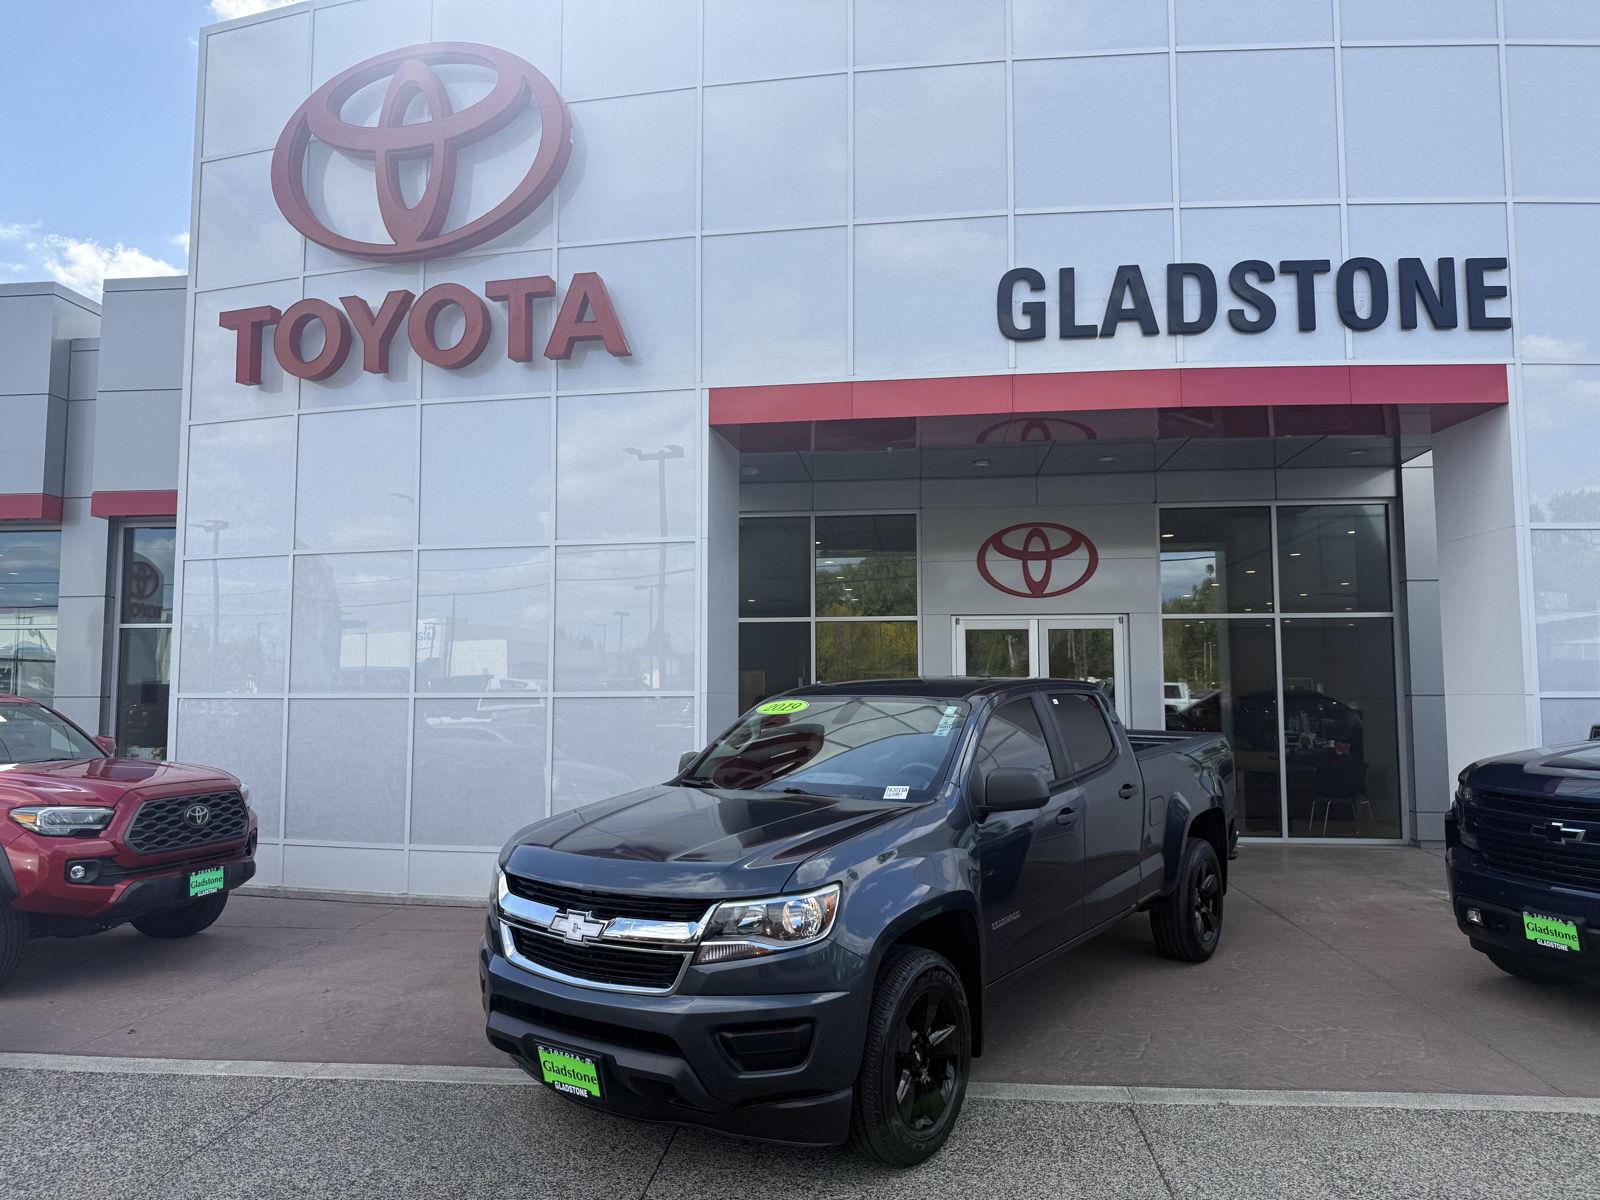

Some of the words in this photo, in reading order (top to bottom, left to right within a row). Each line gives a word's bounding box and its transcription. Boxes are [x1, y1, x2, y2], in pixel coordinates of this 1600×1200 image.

[997, 257, 1512, 342] GLADSTONE
[219, 272, 632, 386] TOYOTA
[762, 702, 802, 712] 2019
[191, 876, 222, 888] Gladstone
[1526, 921, 1578, 942] Gladstone
[1536, 939, 1568, 951] GLADSTONE
[549, 1048, 580, 1060] TOYOTA
[542, 1059, 598, 1085] Gladstone
[554, 1081, 589, 1098] GLADSTONE
